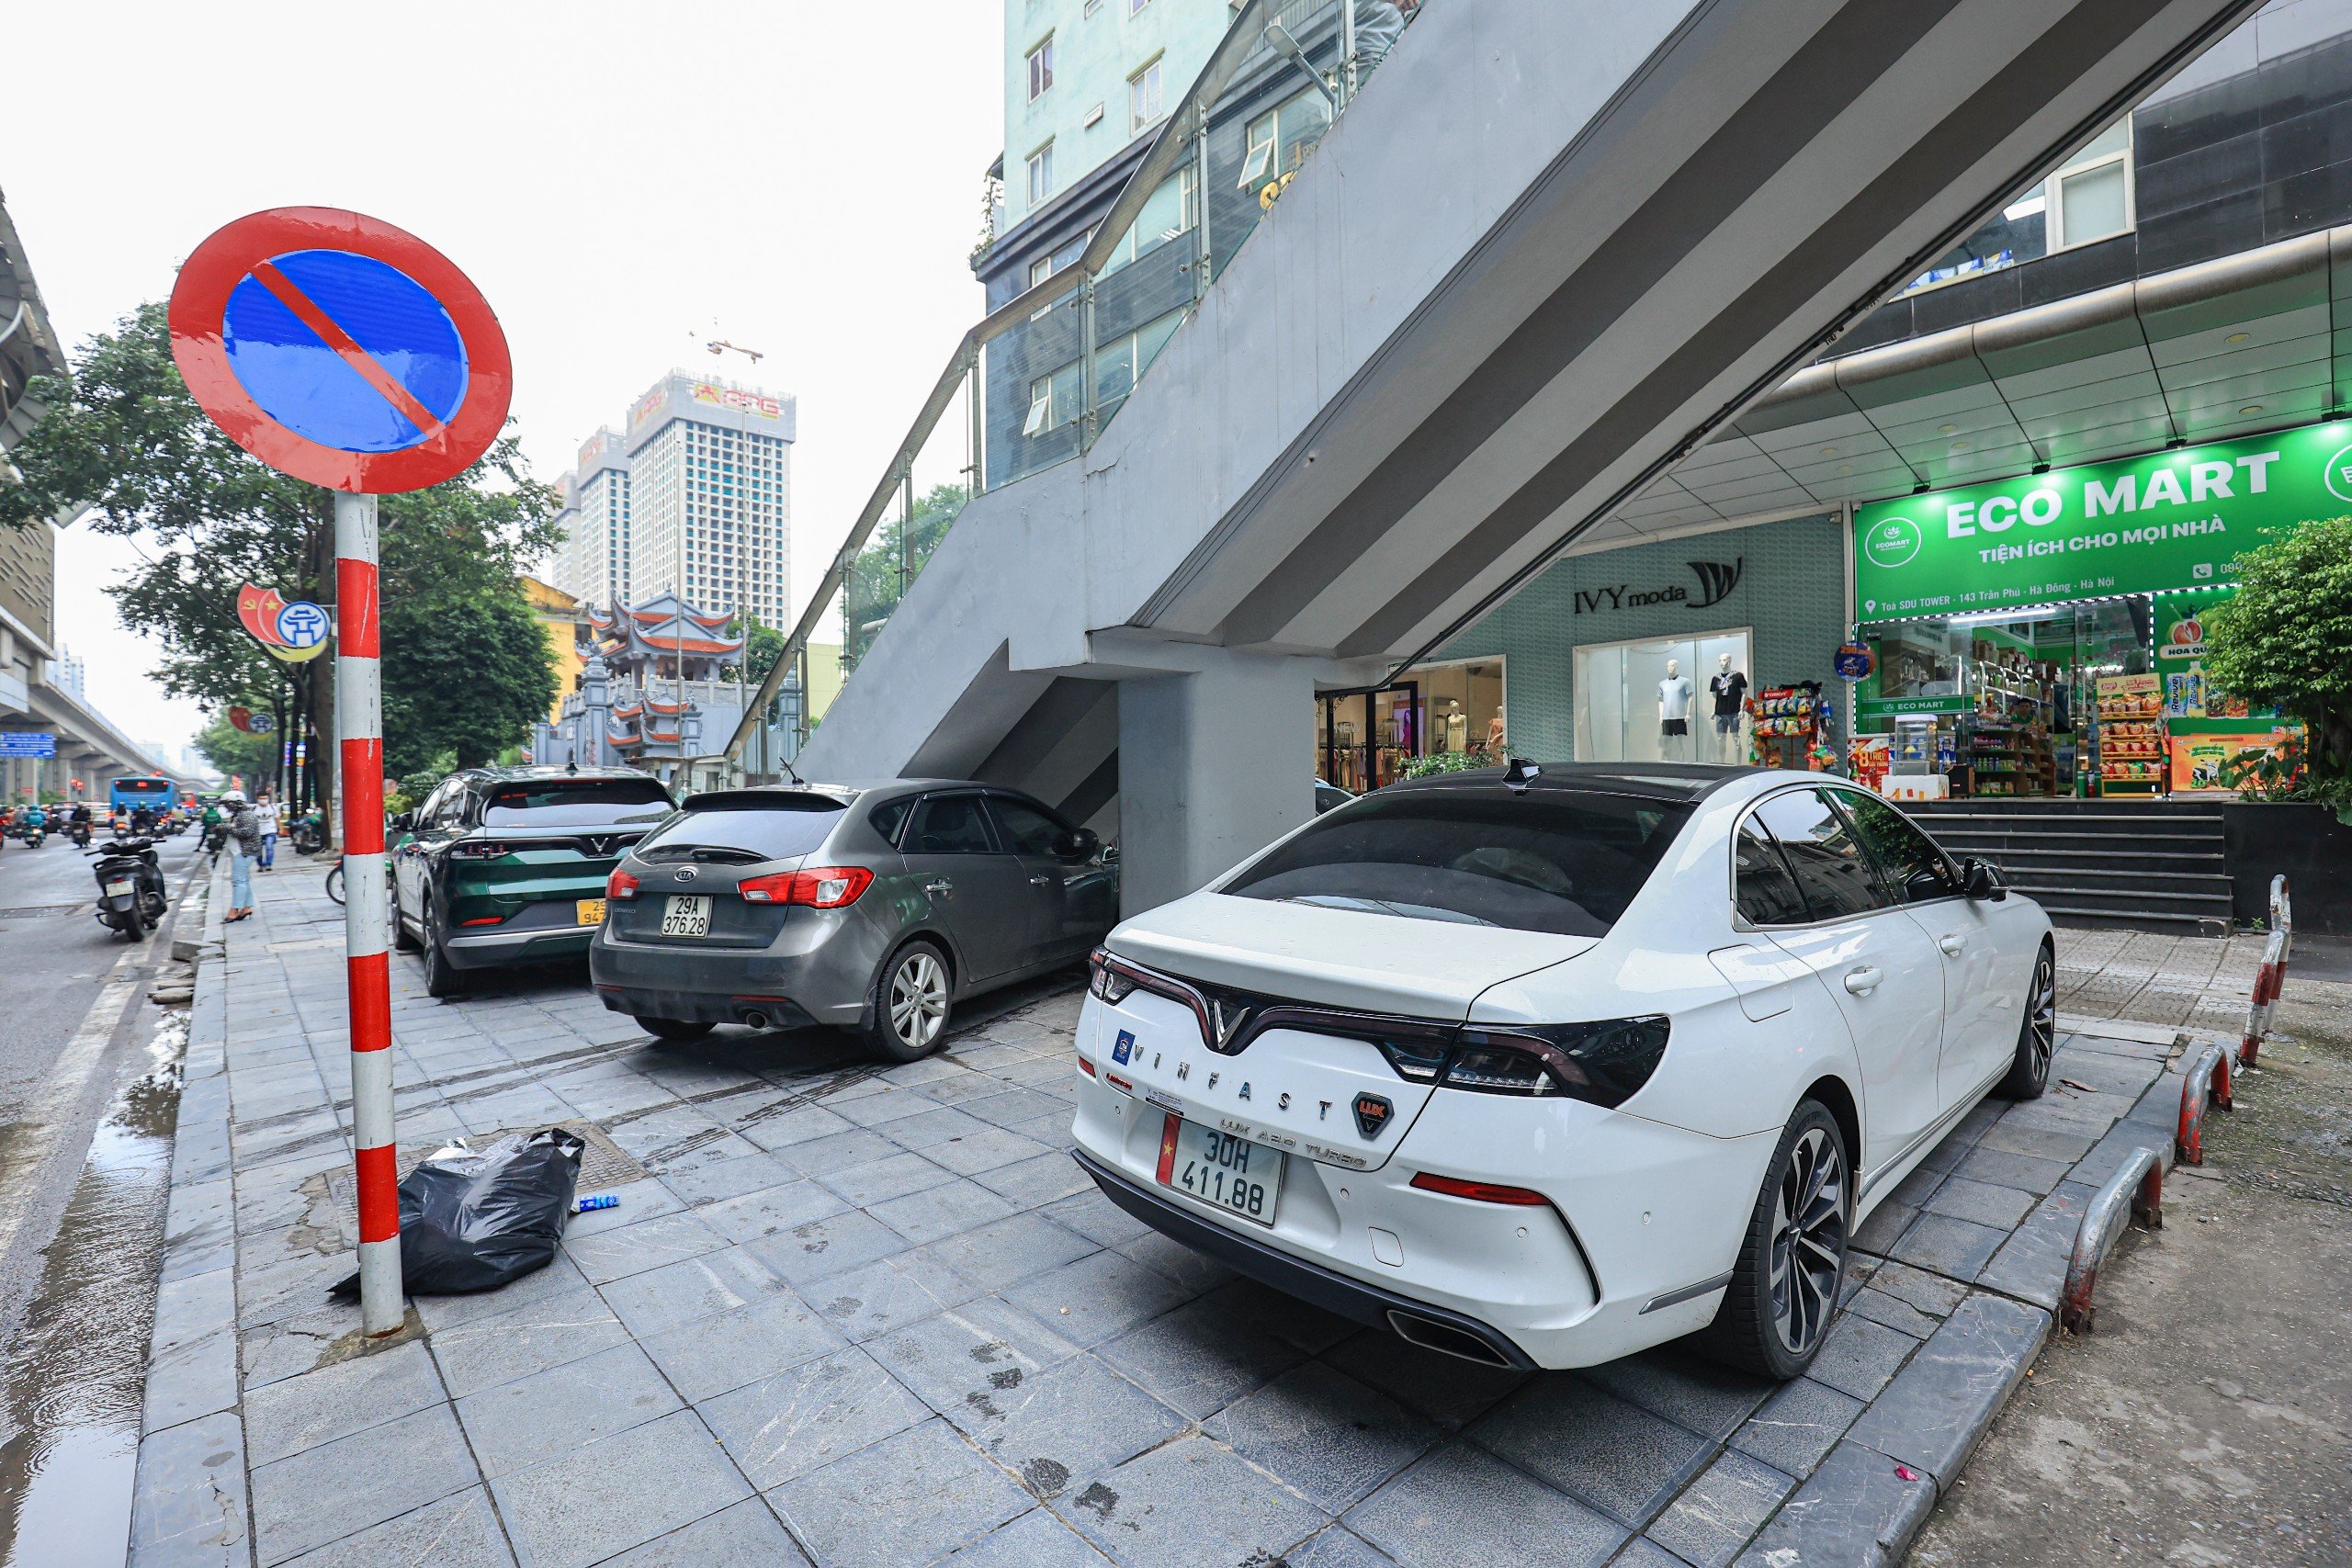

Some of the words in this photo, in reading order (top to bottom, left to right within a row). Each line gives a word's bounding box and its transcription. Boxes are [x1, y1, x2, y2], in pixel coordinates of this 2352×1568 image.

[1946, 488, 2063, 539] ECO
[2084, 450, 2280, 518] MART
[1875, 538, 1910, 549] ECOMART
[1978, 544, 2023, 565] TIỆN
[2027, 538, 2064, 558] ÍCH
[2068, 532, 2118, 552] CHO
[2122, 525, 2168, 546] MỌI
[2172, 513, 2227, 538] NHÀ
[1574, 585, 1628, 615] IVY
[1628, 585, 1688, 607] moda
[1899, 599, 1917, 610] SDU
[1919, 595, 1951, 607] TOWER
[1959, 592, 1976, 604] 143
[2029, 585, 2042, 595] Hà
[2080, 579, 2094, 589] Hà
[2098, 577, 2115, 588] Nội
[2192, 646, 2208, 655] QU
[1897, 702, 1916, 710] ECO
[1918, 701, 1945, 709] MART
[2171, 678, 2179, 710] Revive
[677, 872, 692, 880] KIA
[675, 897, 698, 915] 29A
[663, 916, 706, 935] 376.28
[1135, 1043, 1333, 1121] VINFAST
[1358, 1100, 1386, 1119] LUX
[1204, 1132, 1250, 1174] 30H
[1219, 1118, 1250, 1135] LUX
[1306, 1142, 1367, 1168] TURBO
[1182, 1160, 1264, 1215] 411.88
